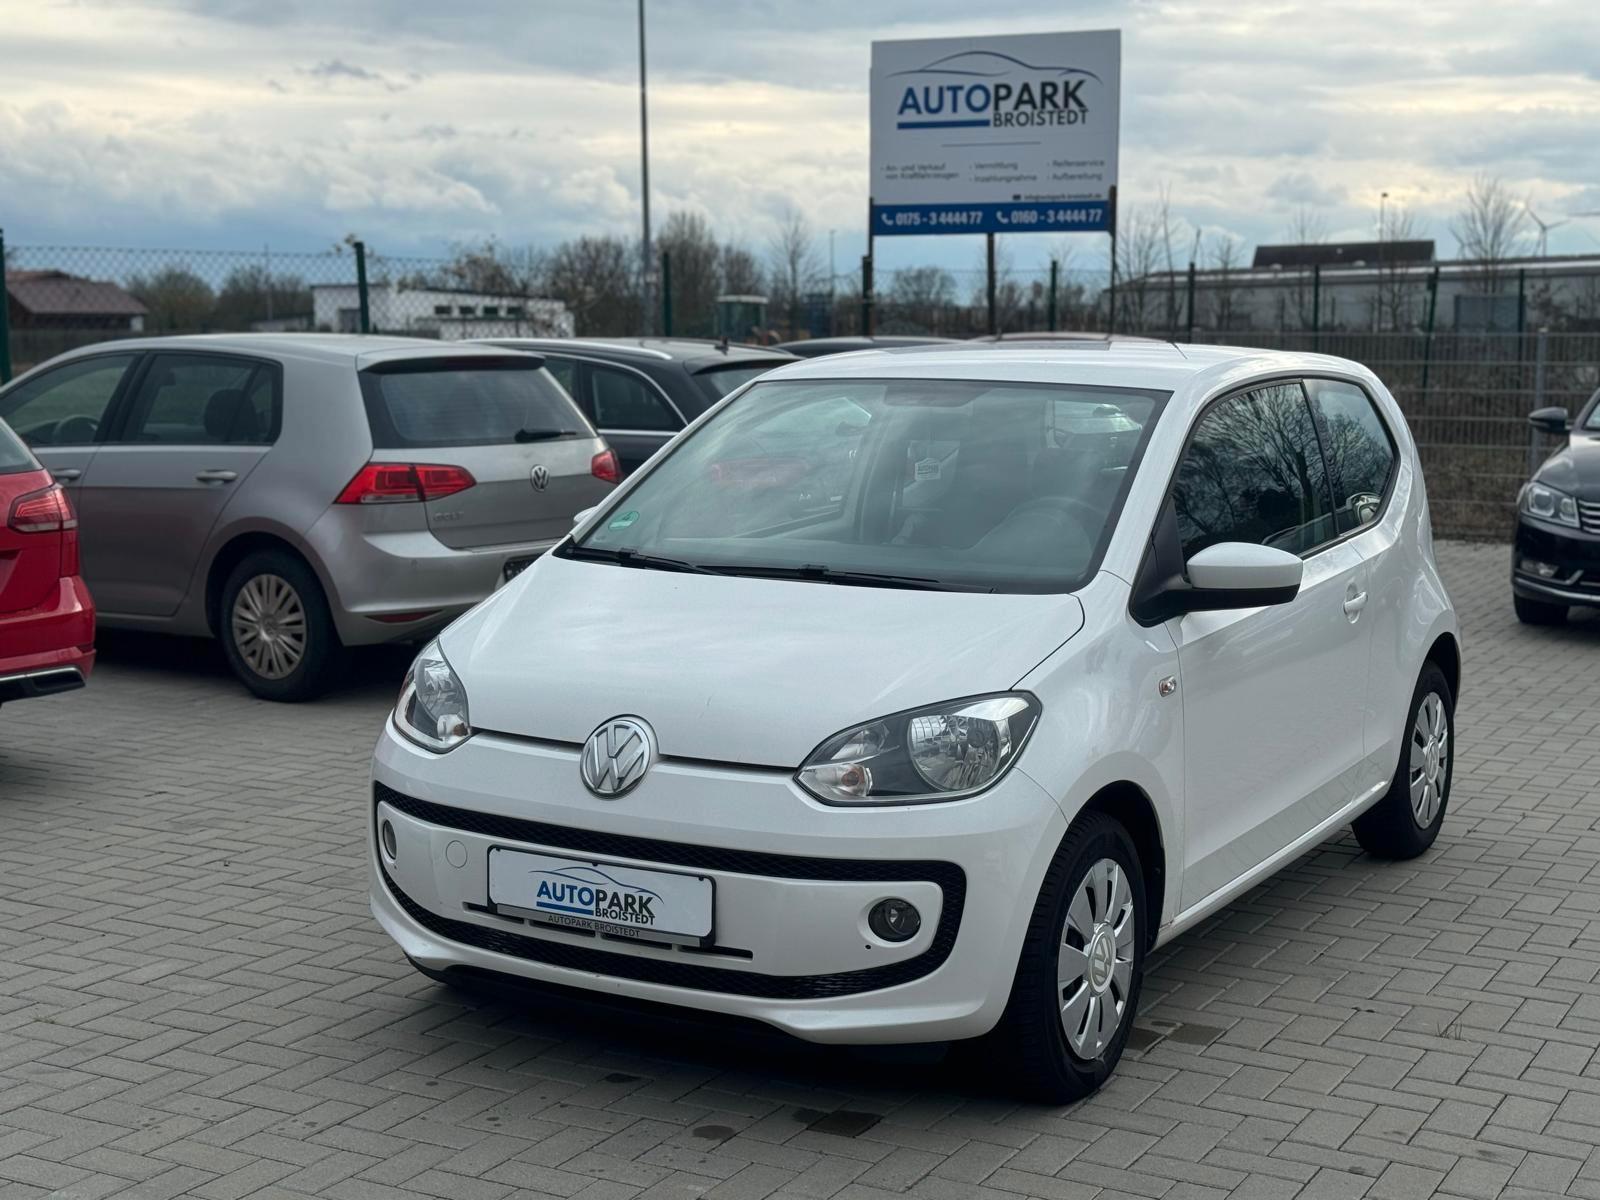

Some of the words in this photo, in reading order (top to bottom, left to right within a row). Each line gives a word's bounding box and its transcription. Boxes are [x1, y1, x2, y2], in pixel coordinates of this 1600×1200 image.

[897, 79, 1087, 116] AUTOPARK
[992, 108, 1089, 128] BROISTEDT
[895, 211, 920, 225] 0175
[1010, 208, 1038, 224] 0160
[536, 880, 654, 916] AUTOPARK
[548, 915, 593, 930] AUTOPARK
[594, 922, 641, 938] BROISTEDT
[595, 908, 656, 926] BROISTEDT
